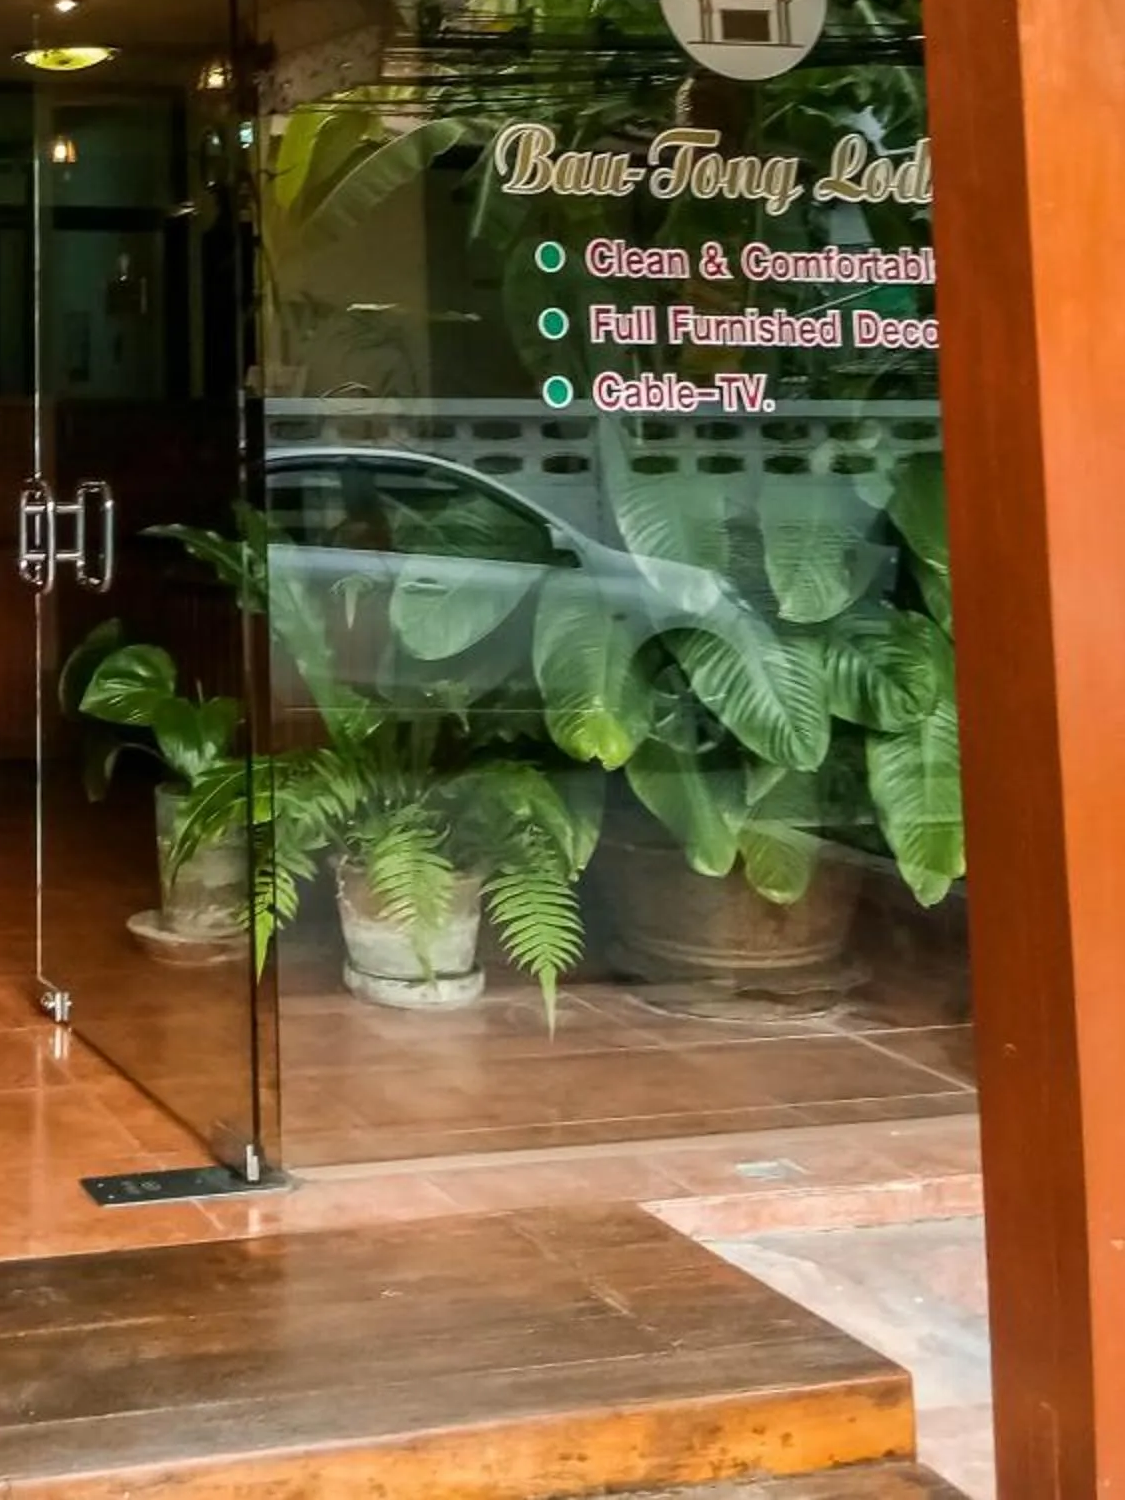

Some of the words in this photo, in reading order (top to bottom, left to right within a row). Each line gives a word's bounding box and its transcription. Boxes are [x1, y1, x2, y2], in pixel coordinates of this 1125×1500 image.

[494, 123, 804, 216] Bau-Tong
[584, 238, 690, 280] Clean
[699, 243, 733, 280] &
[588, 305, 656, 346] Full
[667, 306, 842, 349] Furnished
[851, 309, 940, 350] Deco
[591, 371, 777, 413] Cable-TV.
